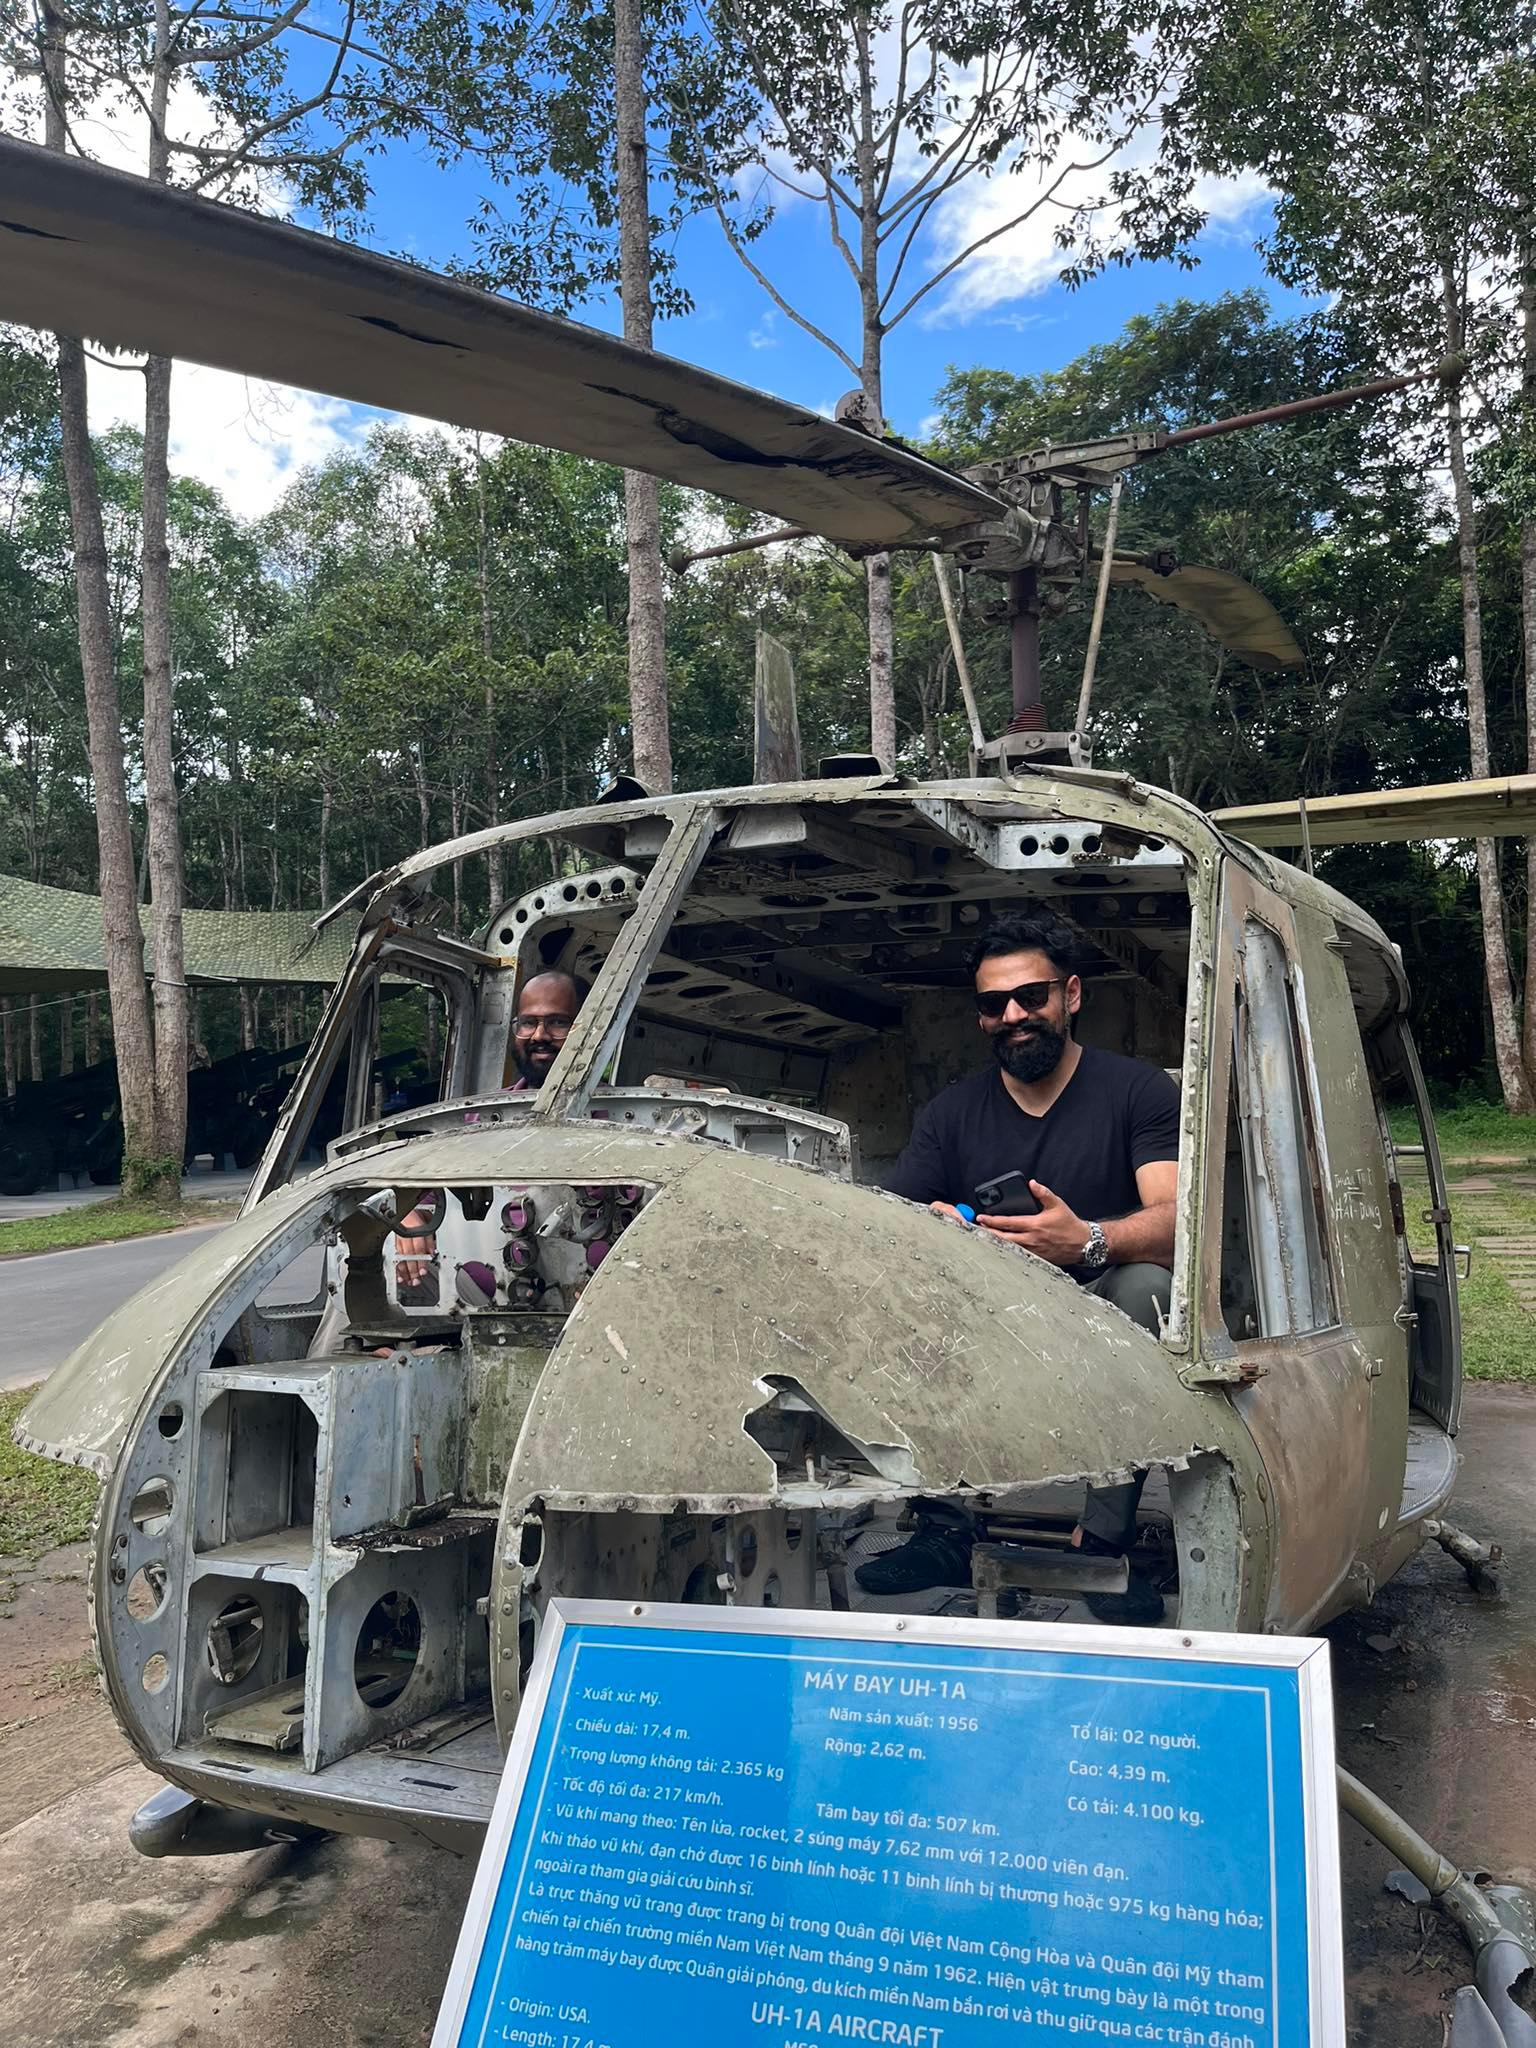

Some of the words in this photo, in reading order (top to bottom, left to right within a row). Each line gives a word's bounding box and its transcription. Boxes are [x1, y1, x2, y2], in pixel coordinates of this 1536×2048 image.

[582, 1687, 613, 1701] Xuất
[639, 1691, 661, 1707] Mỹ.
[804, 1668, 848, 1690] MÁY
[854, 1674, 894, 1694] BAY
[900, 1678, 966, 1700] UH-1A
[614, 1722, 638, 1735] dài:
[644, 1724, 671, 1738] 17,4
[675, 1729, 690, 1739] m.
[829, 1707, 862, 1721] Năm
[866, 1709, 891, 1724] sản
[896, 1712, 933, 1728] xuất:
[939, 1716, 978, 1732] 1956
[824, 1738, 866, 1757] Rộng:
[870, 1741, 904, 1759] 2,62
[908, 1747, 926, 1760] m.
[1070, 1722, 1091, 1740] Tổ
[1095, 1726, 1118, 1742] lái:
[1122, 1729, 1144, 1744] 02
[1149, 1733, 1201, 1750] người.
[570, 1746, 606, 1765] Trọng
[609, 1750, 647, 1769] lượng
[650, 1754, 692, 1773] không
[696, 1757, 717, 1772] tải:
[721, 1760, 762, 1776] 2.365
[766, 1764, 784, 1782] kg
[1069, 1760, 1103, 1776] Cao:
[1108, 1764, 1146, 1781] 4,39
[1151, 1770, 1170, 1783] m.
[562, 1776, 585, 1792] Tốc
[588, 1780, 605, 1796] độ
[609, 1780, 627, 1796] tối
[630, 1784, 650, 1798] đa:
[653, 1786, 682, 1801] 217
[684, 1789, 724, 1806] km/h.
[851, 1806, 880, 1826] bay
[883, 1809, 904, 1826] tối
[908, 1813, 931, 1828] đa:
[936, 1816, 968, 1832] 507
[972, 1819, 1000, 1836] km.
[1068, 1796, 1088, 1812] Có
[1093, 1798, 1118, 1815] tải:
[1123, 1802, 1174, 1820] 4.100
[1179, 1807, 1205, 1827] kg.
[556, 1803, 574, 1818] Vũ
[576, 1806, 598, 1820] khí
[600, 1811, 638, 1828] mang
[642, 1813, 677, 1829] theo:
[682, 1816, 707, 1832] Tên
[740, 1825, 789, 1843] rocket,
[794, 1828, 804, 1844] 2
[808, 1831, 844, 1851] súng
[848, 1836, 881, 1855] máy
[886, 1839, 920, 1856] 7,62
[925, 1846, 954, 1860] mm
[959, 1848, 983, 1864] với
[989, 1851, 1048, 1871] 12.000
[1052, 1858, 1088, 1876] viên
[1092, 1862, 1129, 1882] đạn.
[534, 1858, 573, 1874] ngoài
[573, 1864, 588, 1875] ra
[590, 1863, 625, 1880] tham
[626, 1868, 648, 1884] gia
[650, 1870, 676, 1888] giải
[677, 1874, 703, 1890] cứu
[705, 1876, 737, 1894] binh
[739, 1880, 754, 1896] sĩ.
[540, 1830, 563, 1845] Khi
[567, 1833, 597, 1849] tháo
[601, 1837, 618, 1852] vũ
[621, 1839, 644, 1856] khí,
[649, 1842, 676, 1860] đạn
[708, 1849, 743, 1868] được
[750, 1854, 767, 1869] 16
[771, 1856, 804, 1874] binh
[807, 1860, 836, 1878] lính
[839, 1864, 876, 1885] hoặc
[882, 1869, 899, 1885] 11
[905, 1872, 940, 1890] binh
[945, 1876, 974, 1894] lính
[979, 1880, 994, 1901] bị
[999, 1884, 1058, 1908] thương
[1063, 1890, 1104, 1912] hoặc
[1109, 1896, 1143, 1915] 975
[1149, 1900, 1170, 1921] kg
[1176, 1903, 1220, 1927] hàng
[1225, 1908, 1264, 1930] hóa;
[528, 1881, 544, 1896] Là
[548, 1885, 576, 1902] trực
[624, 1894, 641, 1909] vũ
[645, 1898, 684, 1918] trang
[687, 1902, 722, 1922] được
[727, 1908, 766, 1929] trang
[770, 1912, 784, 1931] bị
[789, 1916, 830, 1938] trong
[834, 1920, 876, 1940] Quân
[880, 1926, 904, 1947] đội
[910, 1930, 943, 1952] Việt
[946, 1935, 984, 1955] Nam
[989, 1940, 1031, 1964] Cộng
[1036, 1946, 1070, 1966] Hòa
[1075, 1952, 1096, 1969] và
[1101, 1955, 1147, 1975] Quân
[1152, 1961, 1179, 1982] đội
[1185, 1964, 1211, 1986] Mỹ
[1216, 1968, 1264, 1989] tham
[521, 1908, 559, 1926] chiến
[563, 1914, 581, 1931] tại
[583, 1917, 621, 1934] chiến
[626, 1923, 673, 1945] trường
[716, 1934, 750, 1953] Nam
[755, 1939, 785, 1960] Việt
[788, 1944, 824, 1964] Nam
[828, 1950, 874, 1974] tháng
[878, 1956, 889, 1972] 9
[892, 1959, 928, 1978] năm
[934, 1964, 982, 1985] 1962.
[986, 1971, 1026, 1992] Hiện
[1030, 1977, 1059, 1998] vật
[1062, 1982, 1111, 2006] trưng
[1115, 1987, 1148, 2010] bày
[1152, 1992, 1168, 2010] là
[1173, 1996, 1210, 2016] một
[1214, 2000, 1265, 2025] trong
[515, 1934, 550, 1956] hàng
[553, 1941, 585, 1958] trăm
[587, 1947, 618, 1966] máy
[619, 1950, 646, 1970] bay
[648, 1954, 684, 1975] được
[686, 1959, 725, 1979] Quân
[726, 1966, 755, 1984] giải
[756, 1970, 808, 1994] phóng,
[811, 1978, 832, 1994] du
[834, 1980, 867, 2000] kích
[911, 1991, 950, 2012] Nam
[952, 1996, 984, 2016] bắn
[986, 2004, 1009, 2020] rơi
[1012, 2006, 1032, 2023] và
[1036, 2009, 1066, 2028] thu
[1098, 2016, 1132, 2038] qua
[1134, 2022, 1164, 2040] các
[1166, 2027, 1204, 2048] trận
[509, 1996, 555, 2018] Origin:
[558, 2005, 590, 2024] USA.
[751, 2001, 822, 2032] UH-1A
[827, 2013, 944, 2048] AIRCRAFT
[502, 2024, 556, 2048] Length:
